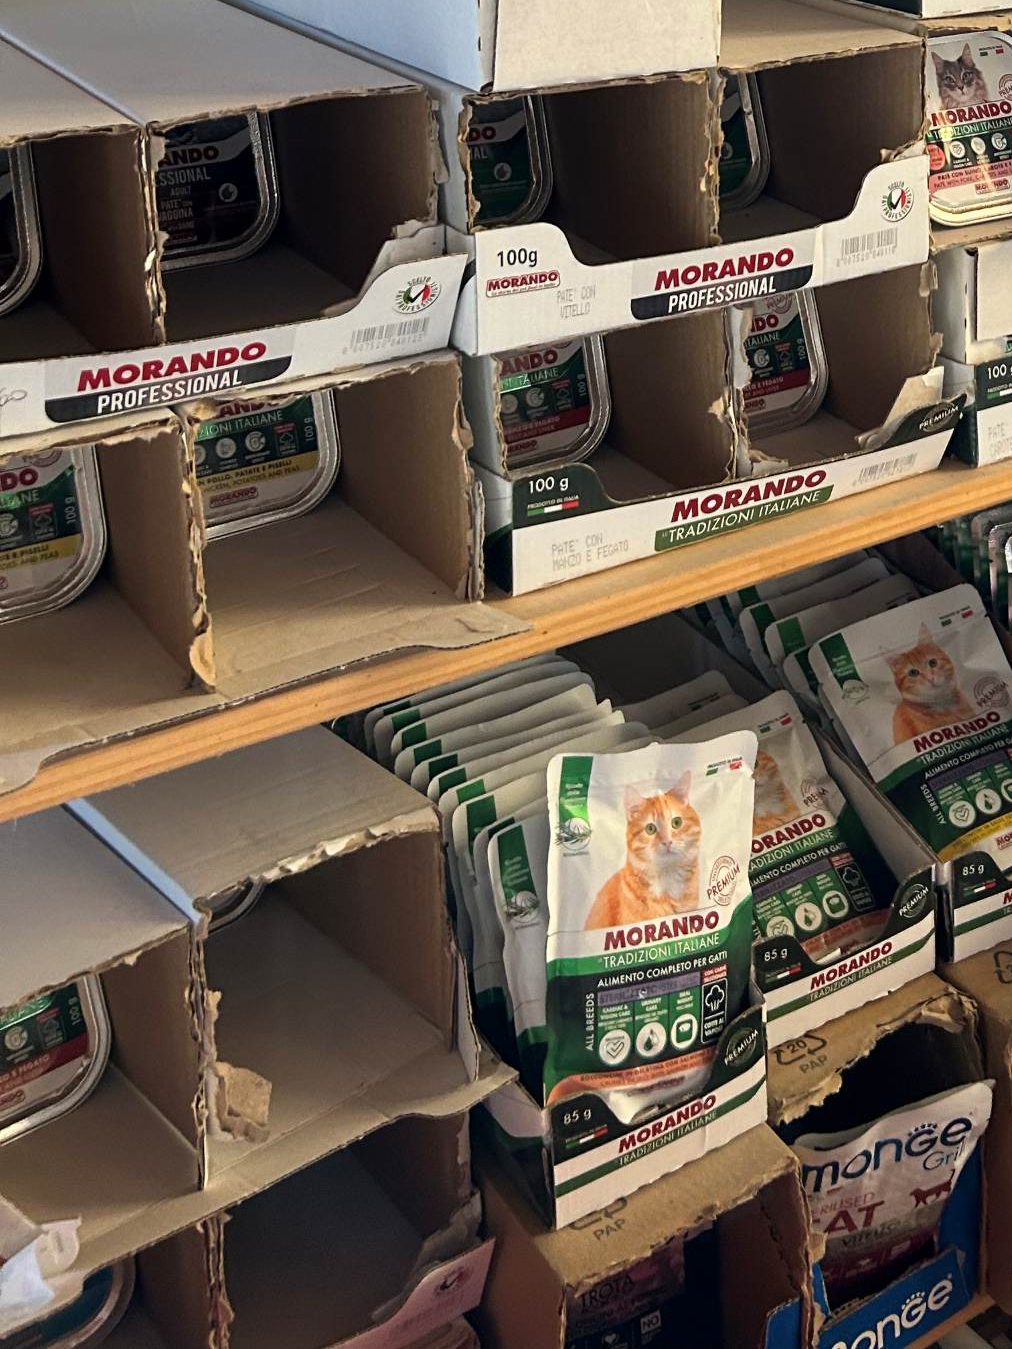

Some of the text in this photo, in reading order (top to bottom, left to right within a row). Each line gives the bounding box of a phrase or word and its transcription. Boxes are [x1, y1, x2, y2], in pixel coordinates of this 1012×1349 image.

[931, 101, 1012, 127] MORANDO
[497, 248, 538, 268] 100g
[655, 247, 794, 291] MORANDO
[488, 272, 558, 291] MORANDO
[668, 276, 777, 314] PROFESSIONAL
[77, 342, 267, 392] MORANDO
[988, 364, 1007, 379] 100
[97, 370, 242, 414] PROFESSIONAL
[235, 411, 283, 429] ITALIANE
[919, 403, 960, 430] PREMIUM
[529, 477, 569, 494] 100 g
[671, 469, 827, 523] MORANDO
[668, 489, 821, 543] TRADIZIONI ITALIANE
[913, 712, 1000, 753] MORANDO
[920, 739, 969, 765] TRADIZIONI
[925, 758, 959, 779] ALIMENTO
[750, 828, 834, 871] ADIZIONI ITALIANE
[751, 813, 827, 856] ORANDO
[706, 863, 741, 899] PREMIUM
[780, 856, 816, 877] COMPLETO
[962, 865, 976, 877] 85
[899, 887, 929, 916] PREMIUM
[603, 910, 720, 951] MORANDO
[603, 932, 720, 968] TRADIZIONI ITALIANE
[764, 947, 788, 962] 85 g
[811, 942, 893, 991] MORANDO
[597, 950, 728, 988] ALIMENTO COMPLETO PER GATTI
[810, 956, 893, 1001] TRADIZIONI ITALIANE
[585, 993, 594, 1050] ALL BREEDS
[724, 1029, 759, 1065] PREMIUM
[799, 1055, 828, 1074] PAP
[563, 1109, 592, 1125] 85 g
[618, 1094, 716, 1153] MORANDO
[618, 1111, 717, 1166] TRADIZIONI ITALIANE
[593, 1218, 626, 1242] PAP
